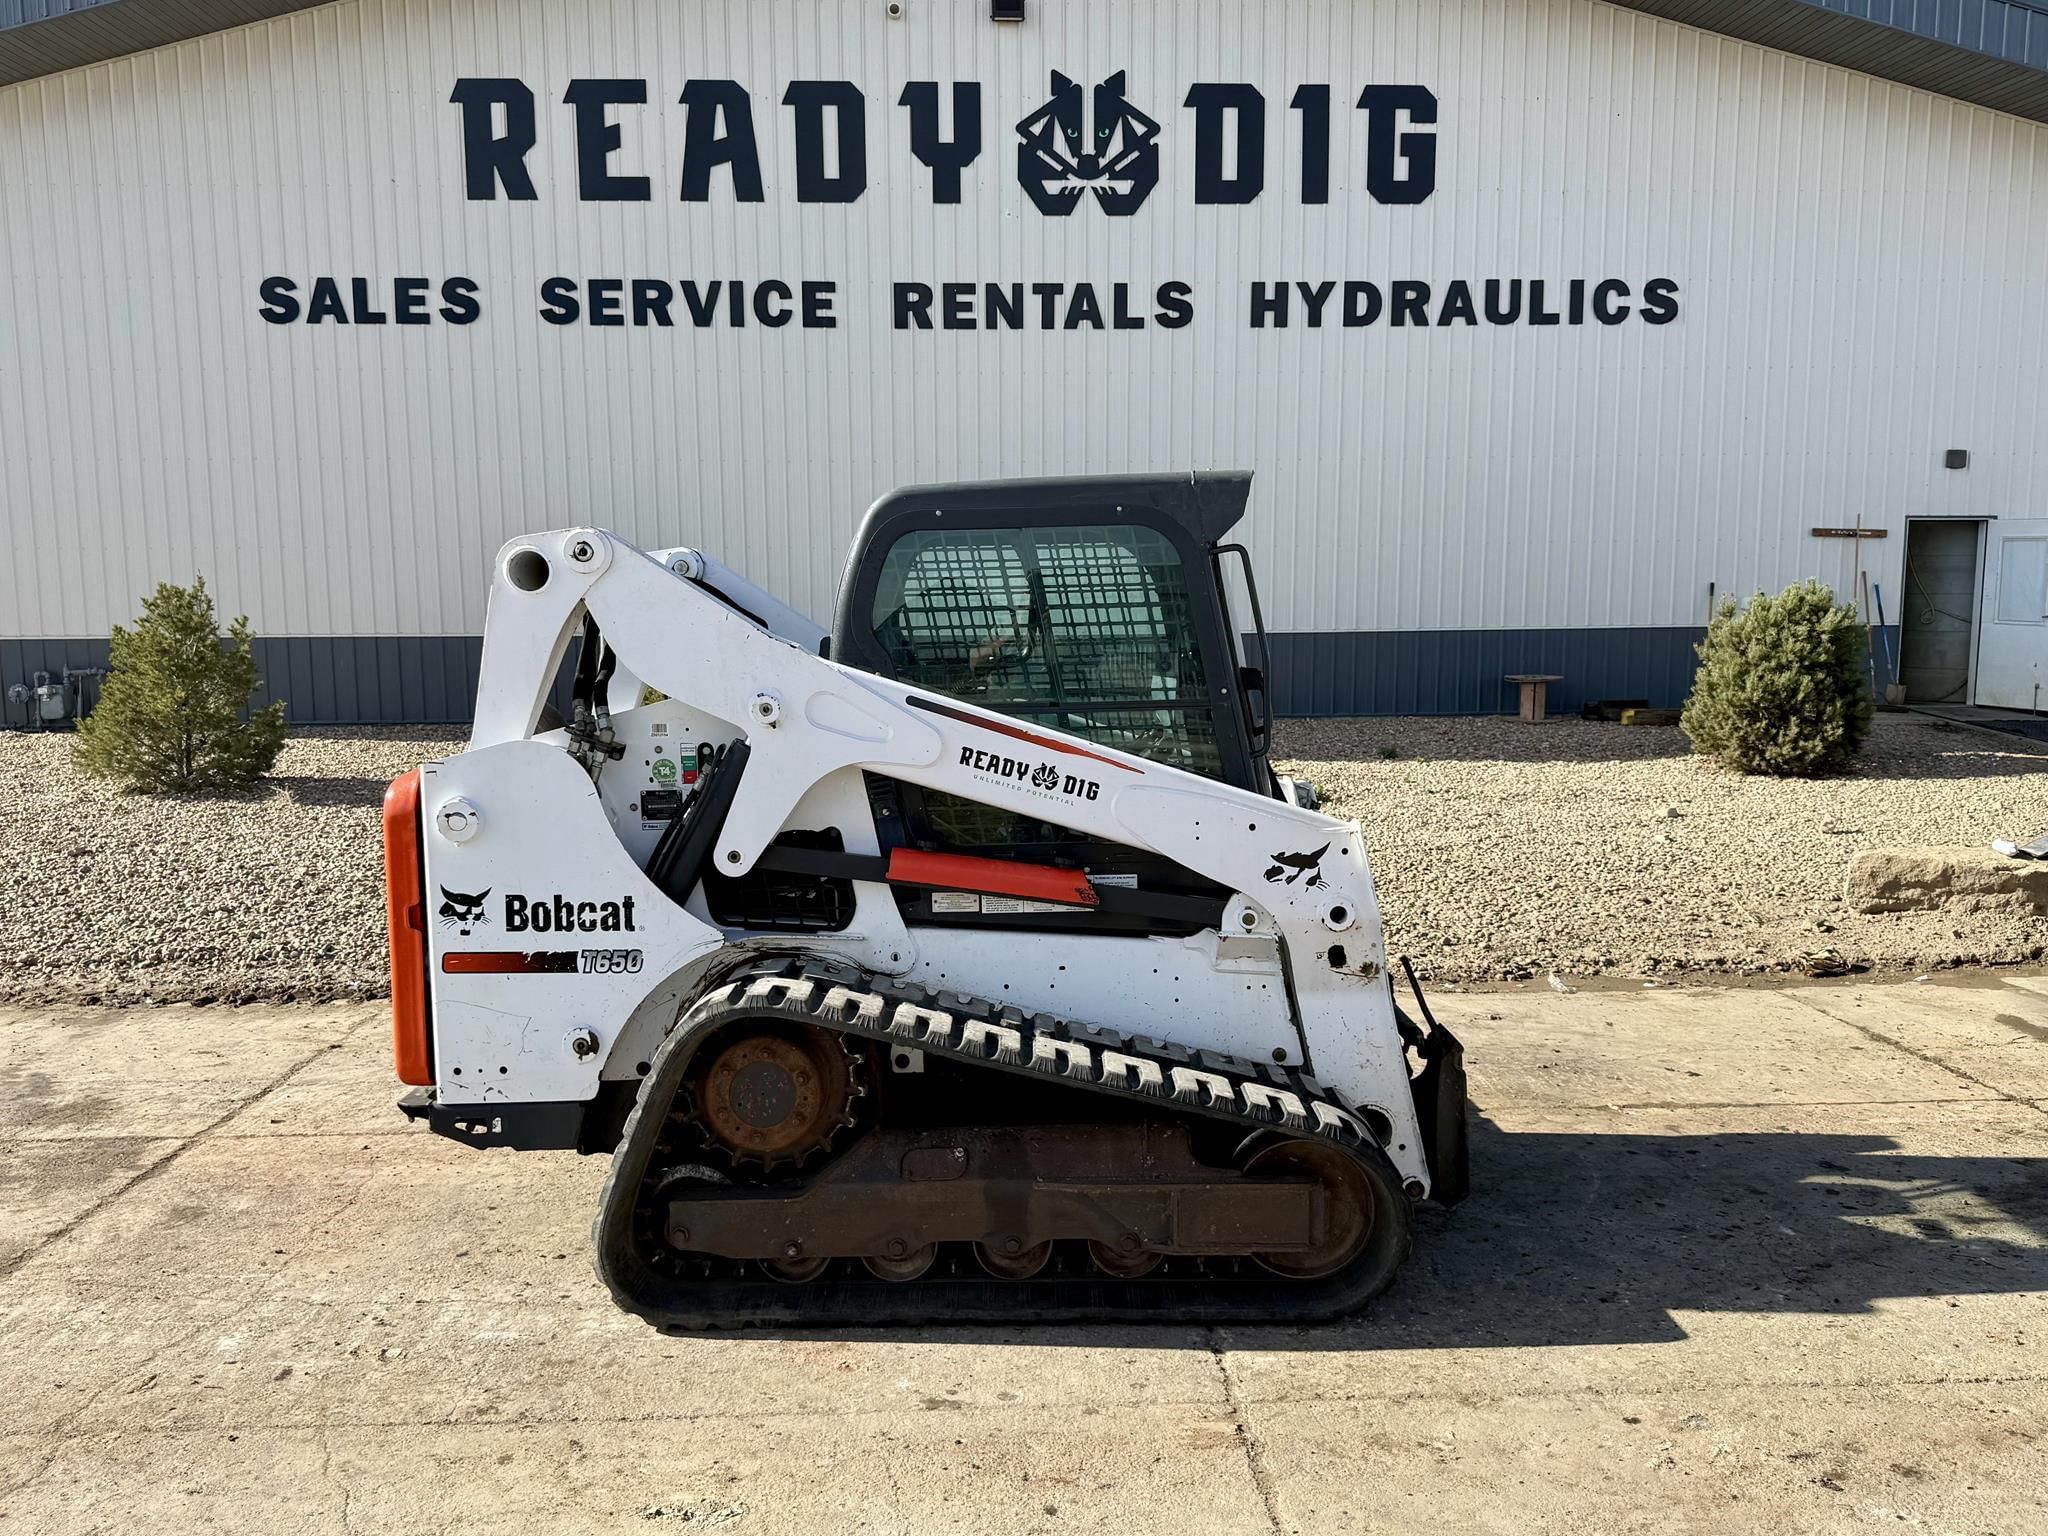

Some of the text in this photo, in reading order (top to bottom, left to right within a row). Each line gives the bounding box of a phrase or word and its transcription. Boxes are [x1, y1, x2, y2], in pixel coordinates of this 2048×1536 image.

[449, 78, 1437, 204] READY DIG
[259, 277, 1678, 329] SALES SERVICE RENTALS HYDRAULICS
[658, 766, 670, 776] T4
[959, 746, 1100, 801] READY DIG
[973, 774, 1075, 806] UNLIMITED POTENTIAL
[505, 894, 636, 933] Bobcat
[581, 949, 644, 974] T650
